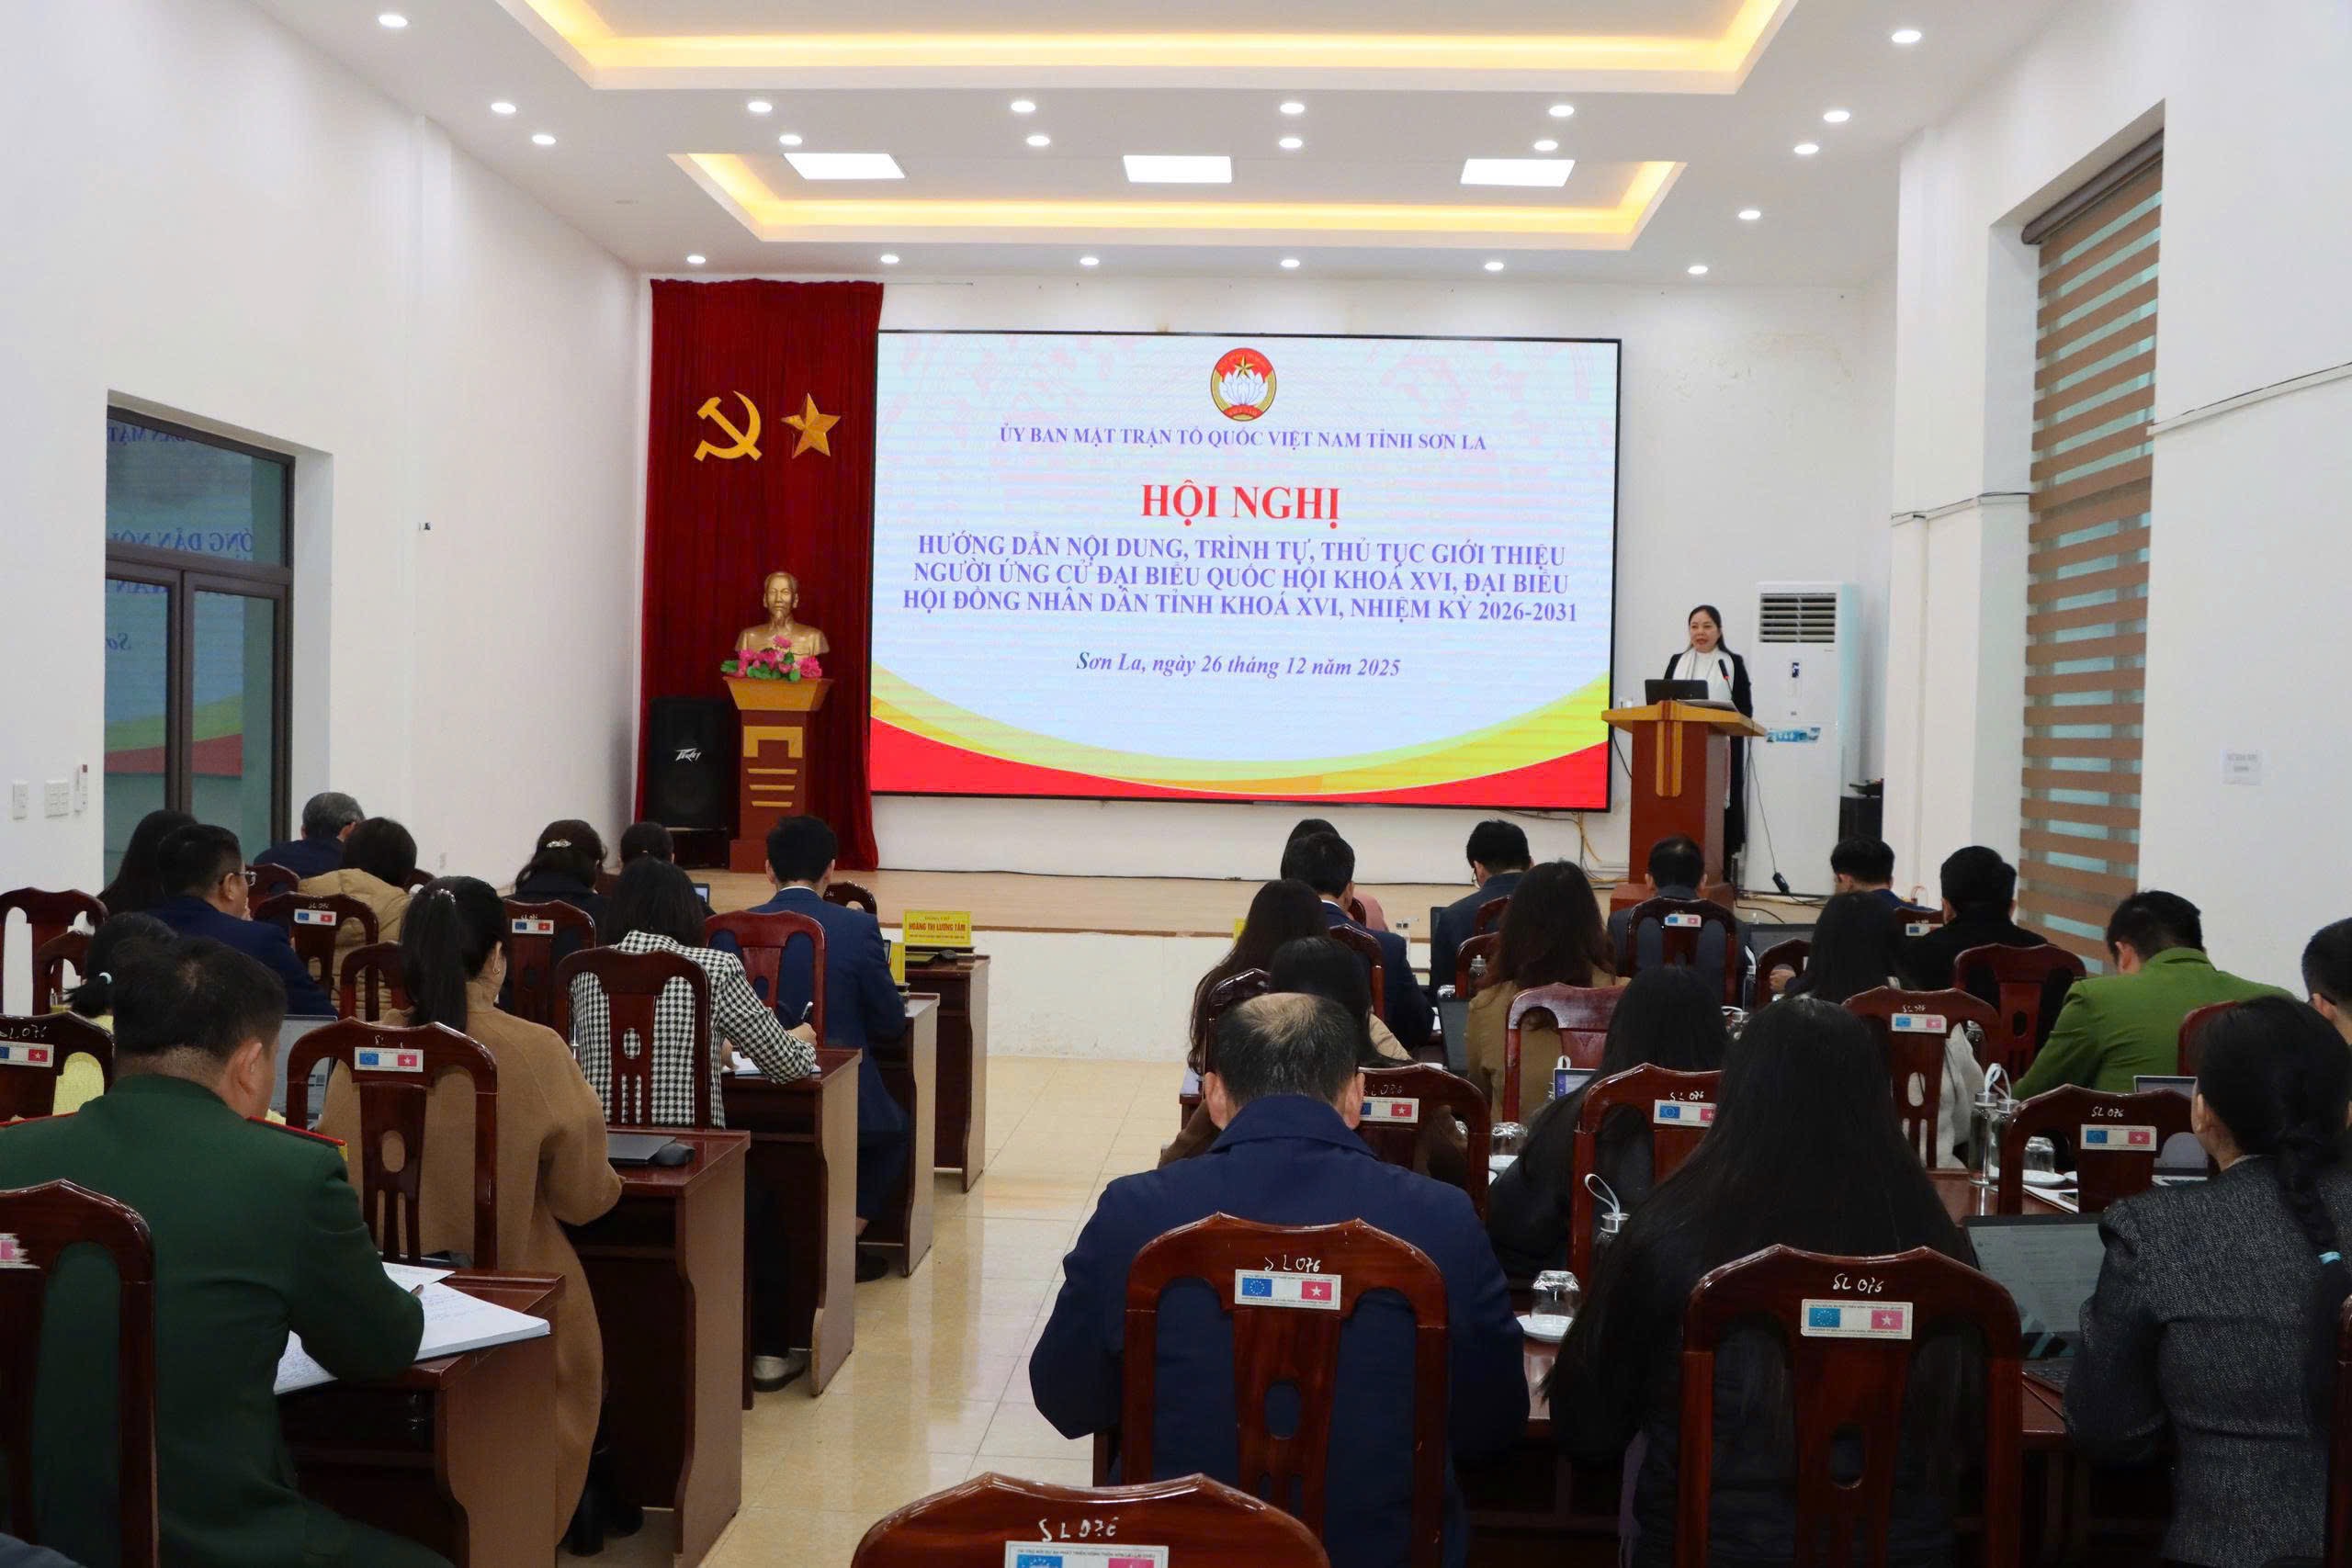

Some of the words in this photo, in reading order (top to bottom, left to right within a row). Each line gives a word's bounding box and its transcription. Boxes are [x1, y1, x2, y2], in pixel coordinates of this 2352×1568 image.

[1030, 426, 1069, 444] BAN
[1208, 425, 1263, 448] QUỐC
[1268, 427, 1314, 451] VIỆT
[1317, 430, 1362, 448] NAM
[1366, 427, 1413, 450] TỈNH
[1419, 432, 1458, 450] SƠN
[1462, 434, 1487, 451] LA
[1141, 479, 1219, 527] HỘI
[1232, 485, 1341, 530] NGHỊ
[919, 529, 1005, 556] HƯỚNG
[1012, 530, 1061, 556] DẪN
[1067, 535, 1110, 561] NỘI
[1116, 537, 1189, 562] DUNG,
[1194, 535, 1269, 562] TRÌNH
[1275, 538, 1315, 566] TỰ,
[1320, 536, 1370, 562] THỦ
[1376, 542, 1425, 568] TỤC
[1431, 538, 1485, 565] GIỚI
[1491, 543, 1566, 570] THIỆU
[913, 558, 991, 583] NGƯỜI
[1000, 558, 1050, 584] ỨNG
[1057, 558, 1093, 585] CỬ
[1097, 565, 1139, 590] ĐẠI
[1145, 561, 1201, 587] BIỂU
[1206, 563, 1276, 592] QUỐC
[1283, 566, 1327, 593] HỘI
[1334, 564, 1404, 590] KHOÁ
[1410, 571, 1458, 595] XVI,
[1464, 571, 1507, 597] ĐẠI
[1513, 569, 1570, 594] BIỂU
[903, 587, 946, 615] HỘI
[953, 585, 1021, 611] ĐỒNG
[1027, 585, 1093, 612] NHÂN
[1101, 586, 1149, 613] DÂN
[1155, 588, 1213, 615] TỈNH
[1220, 590, 1290, 616] KHOÁ
[1296, 596, 1344, 620] XVI,
[1351, 596, 1430, 624] NHIỆM
[1438, 594, 1473, 620] KỲ
[1477, 601, 1577, 623] 2026-2031
[1076, 651, 1113, 671] Sơn
[1118, 653, 1147, 674] La,
[1152, 654, 1196, 678] ngày
[1201, 655, 1223, 673] 26
[1227, 655, 1281, 679] tháng
[1285, 656, 1307, 675] 12
[1311, 658, 1352, 677] năm
[1357, 658, 1402, 677] 2025
